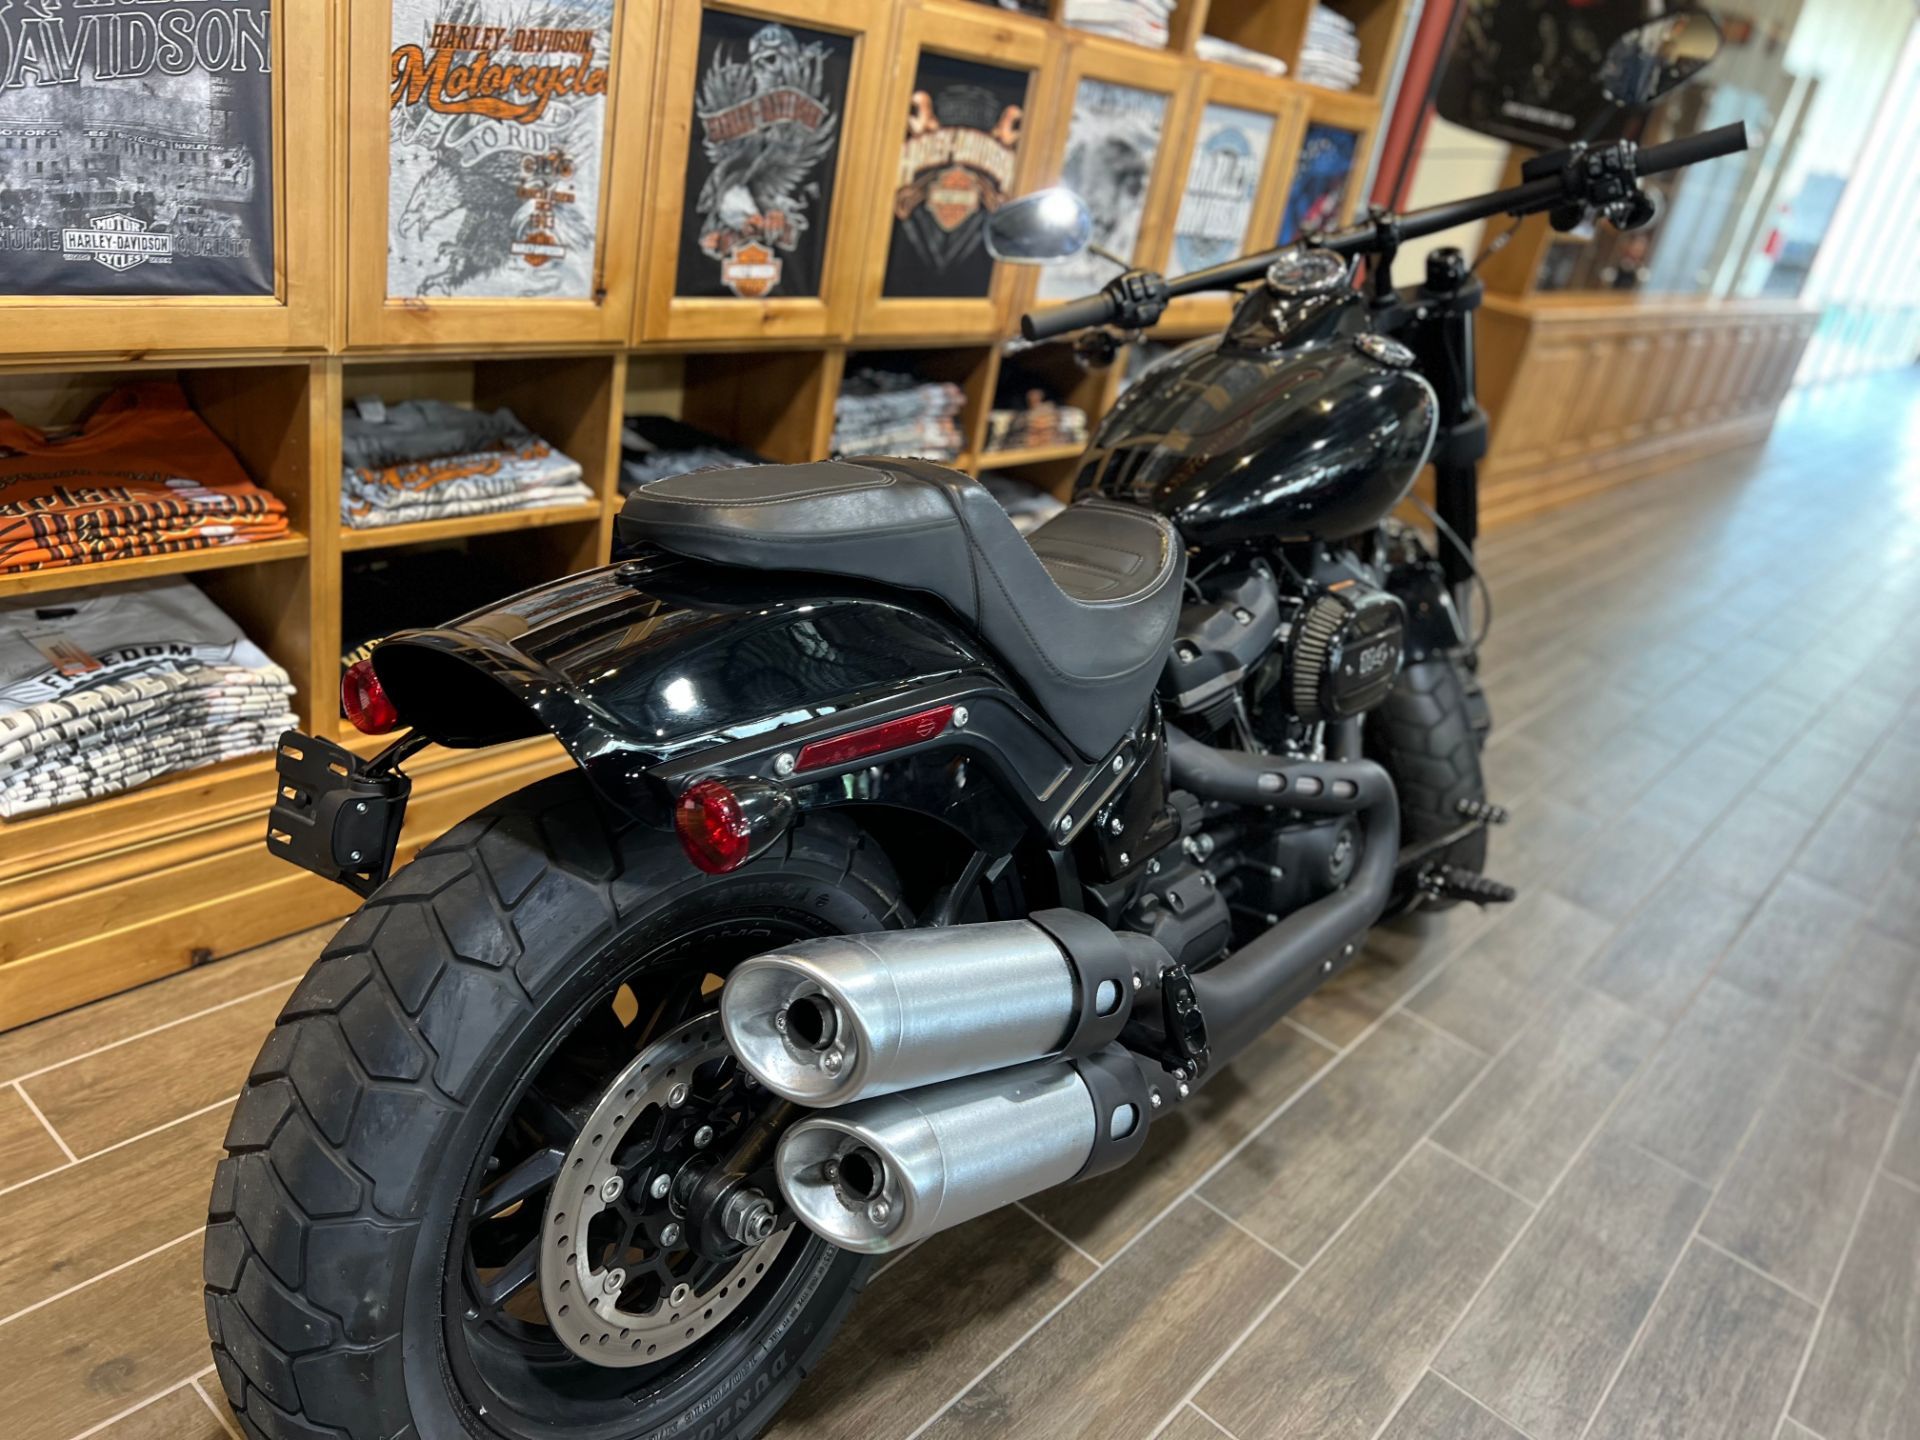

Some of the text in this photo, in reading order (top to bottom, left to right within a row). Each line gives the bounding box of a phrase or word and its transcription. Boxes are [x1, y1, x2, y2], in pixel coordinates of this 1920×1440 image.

[0, 8, 271, 92] AVIDSON
[430, 24, 594, 53] HARLEY-DAVIDSON
[96, 216, 141, 231] MOTOR
[68, 234, 169, 251] HARLEY-DAVIDSON
[99, 254, 141, 267] CYCLES
[692, 1350, 789, 1440] DUNLO
